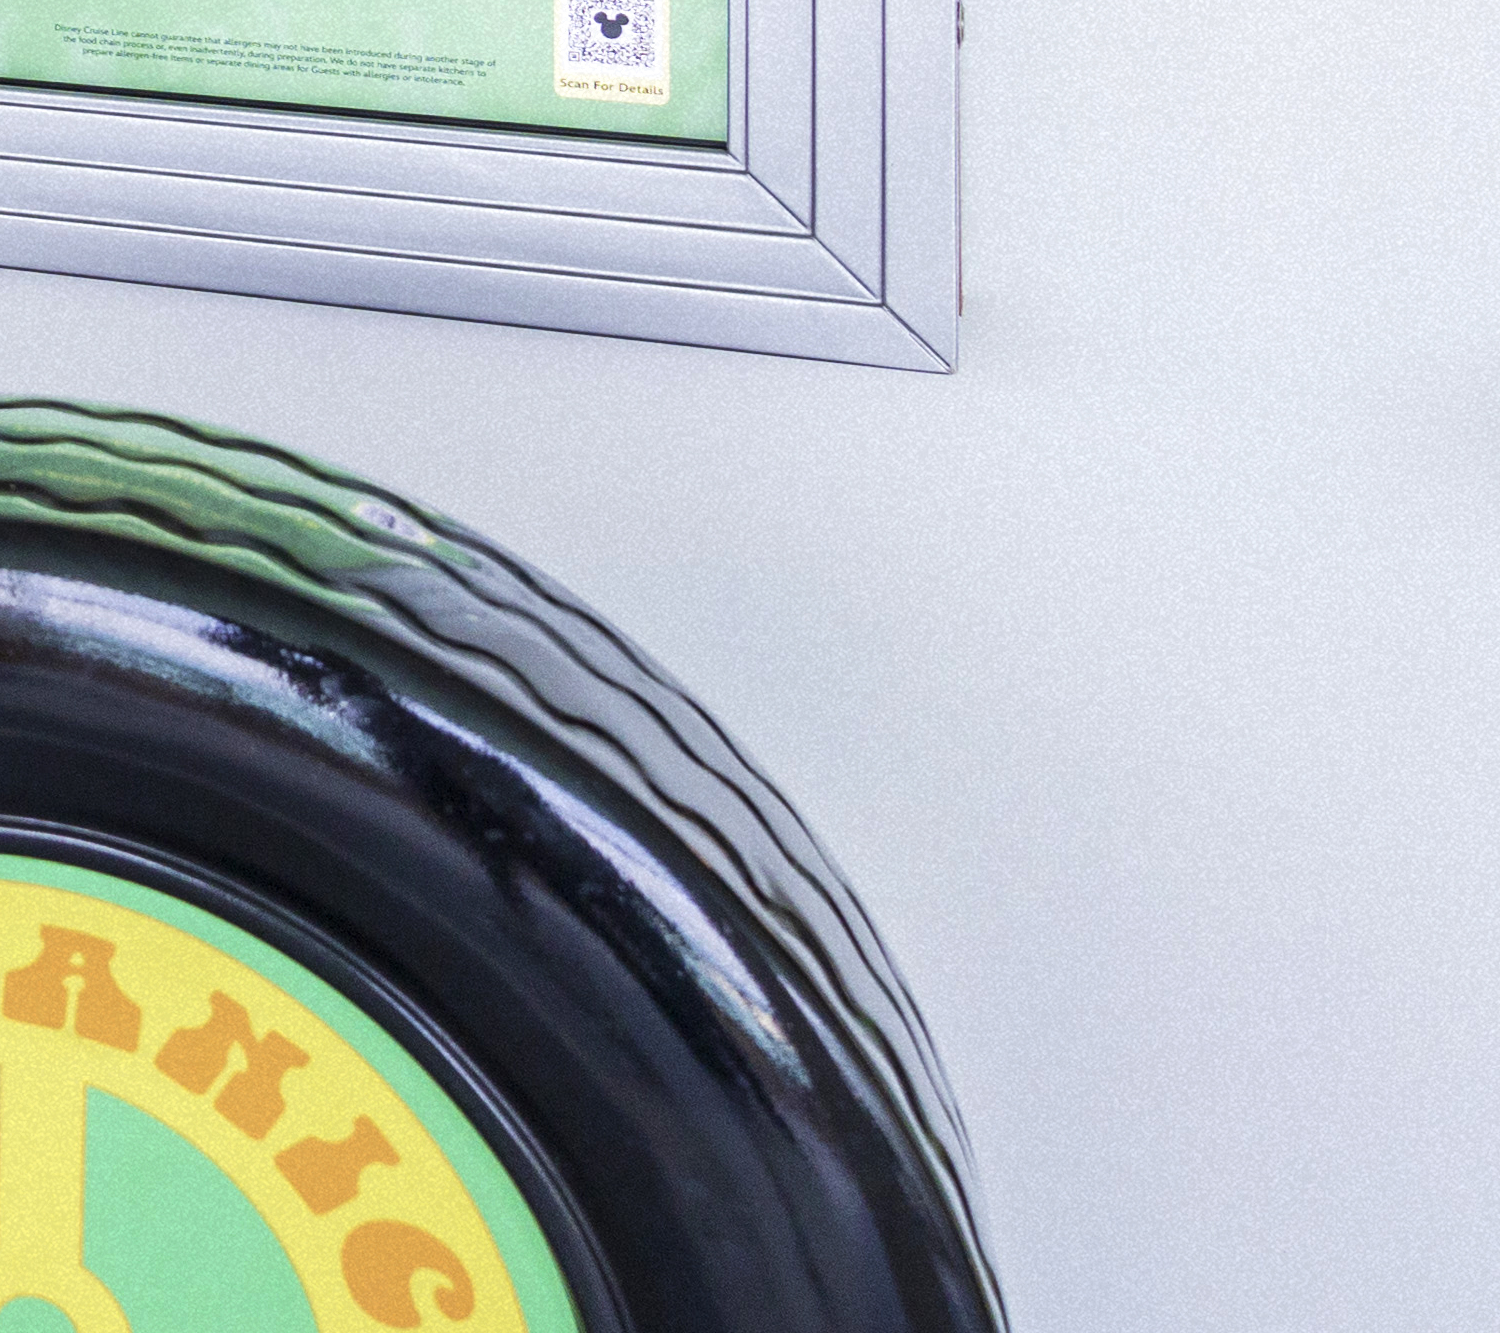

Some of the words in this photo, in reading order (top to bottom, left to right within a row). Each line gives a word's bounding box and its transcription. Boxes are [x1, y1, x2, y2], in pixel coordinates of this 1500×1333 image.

[54, 24, 82, 34] Disney
[83, 26, 109, 35] Cruise
[111, 28, 128, 37] Line
[131, 31, 158, 40] cannot
[161, 33, 201, 43] guarantee
[204, 36, 220, 44] that
[223, 38, 261, 48] allergens
[264, 41, 281, 51] may
[283, 43, 298, 51] not
[300, 44, 319, 53] have
[321, 46, 343, 54] been
[345, 48, 391, 59] introduced
[394, 51, 422, 62] during
[425, 55, 458, 64] another
[461, 58, 485, 68] stage
[487, 59, 496, 67] of
[78, 36, 97, 44] food
[99, 38, 120, 47] chain
[123, 41, 153, 50] process
[168, 44, 187, 52] even
[248, 51, 275, 61] during
[330, 57, 344, 65] We
[346, 58, 357, 66] do
[360, 60, 374, 68] not
[377, 61, 397, 70] have
[399, 64, 436, 74] separate
[438, 66, 474, 76] kitchens
[477, 69, 487, 77] to
[82, 47, 114, 57] prepare
[207, 58, 242, 68] separate
[244, 61, 271, 71] dining
[273, 64, 295, 72] areas
[297, 64, 308, 72] for
[311, 65, 340, 76] Guests
[343, 69, 361, 78] with
[363, 70, 399, 81] allergies
[560, 78, 589, 90] Scan
[594, 80, 614, 91] For
[619, 82, 664, 95] Details
